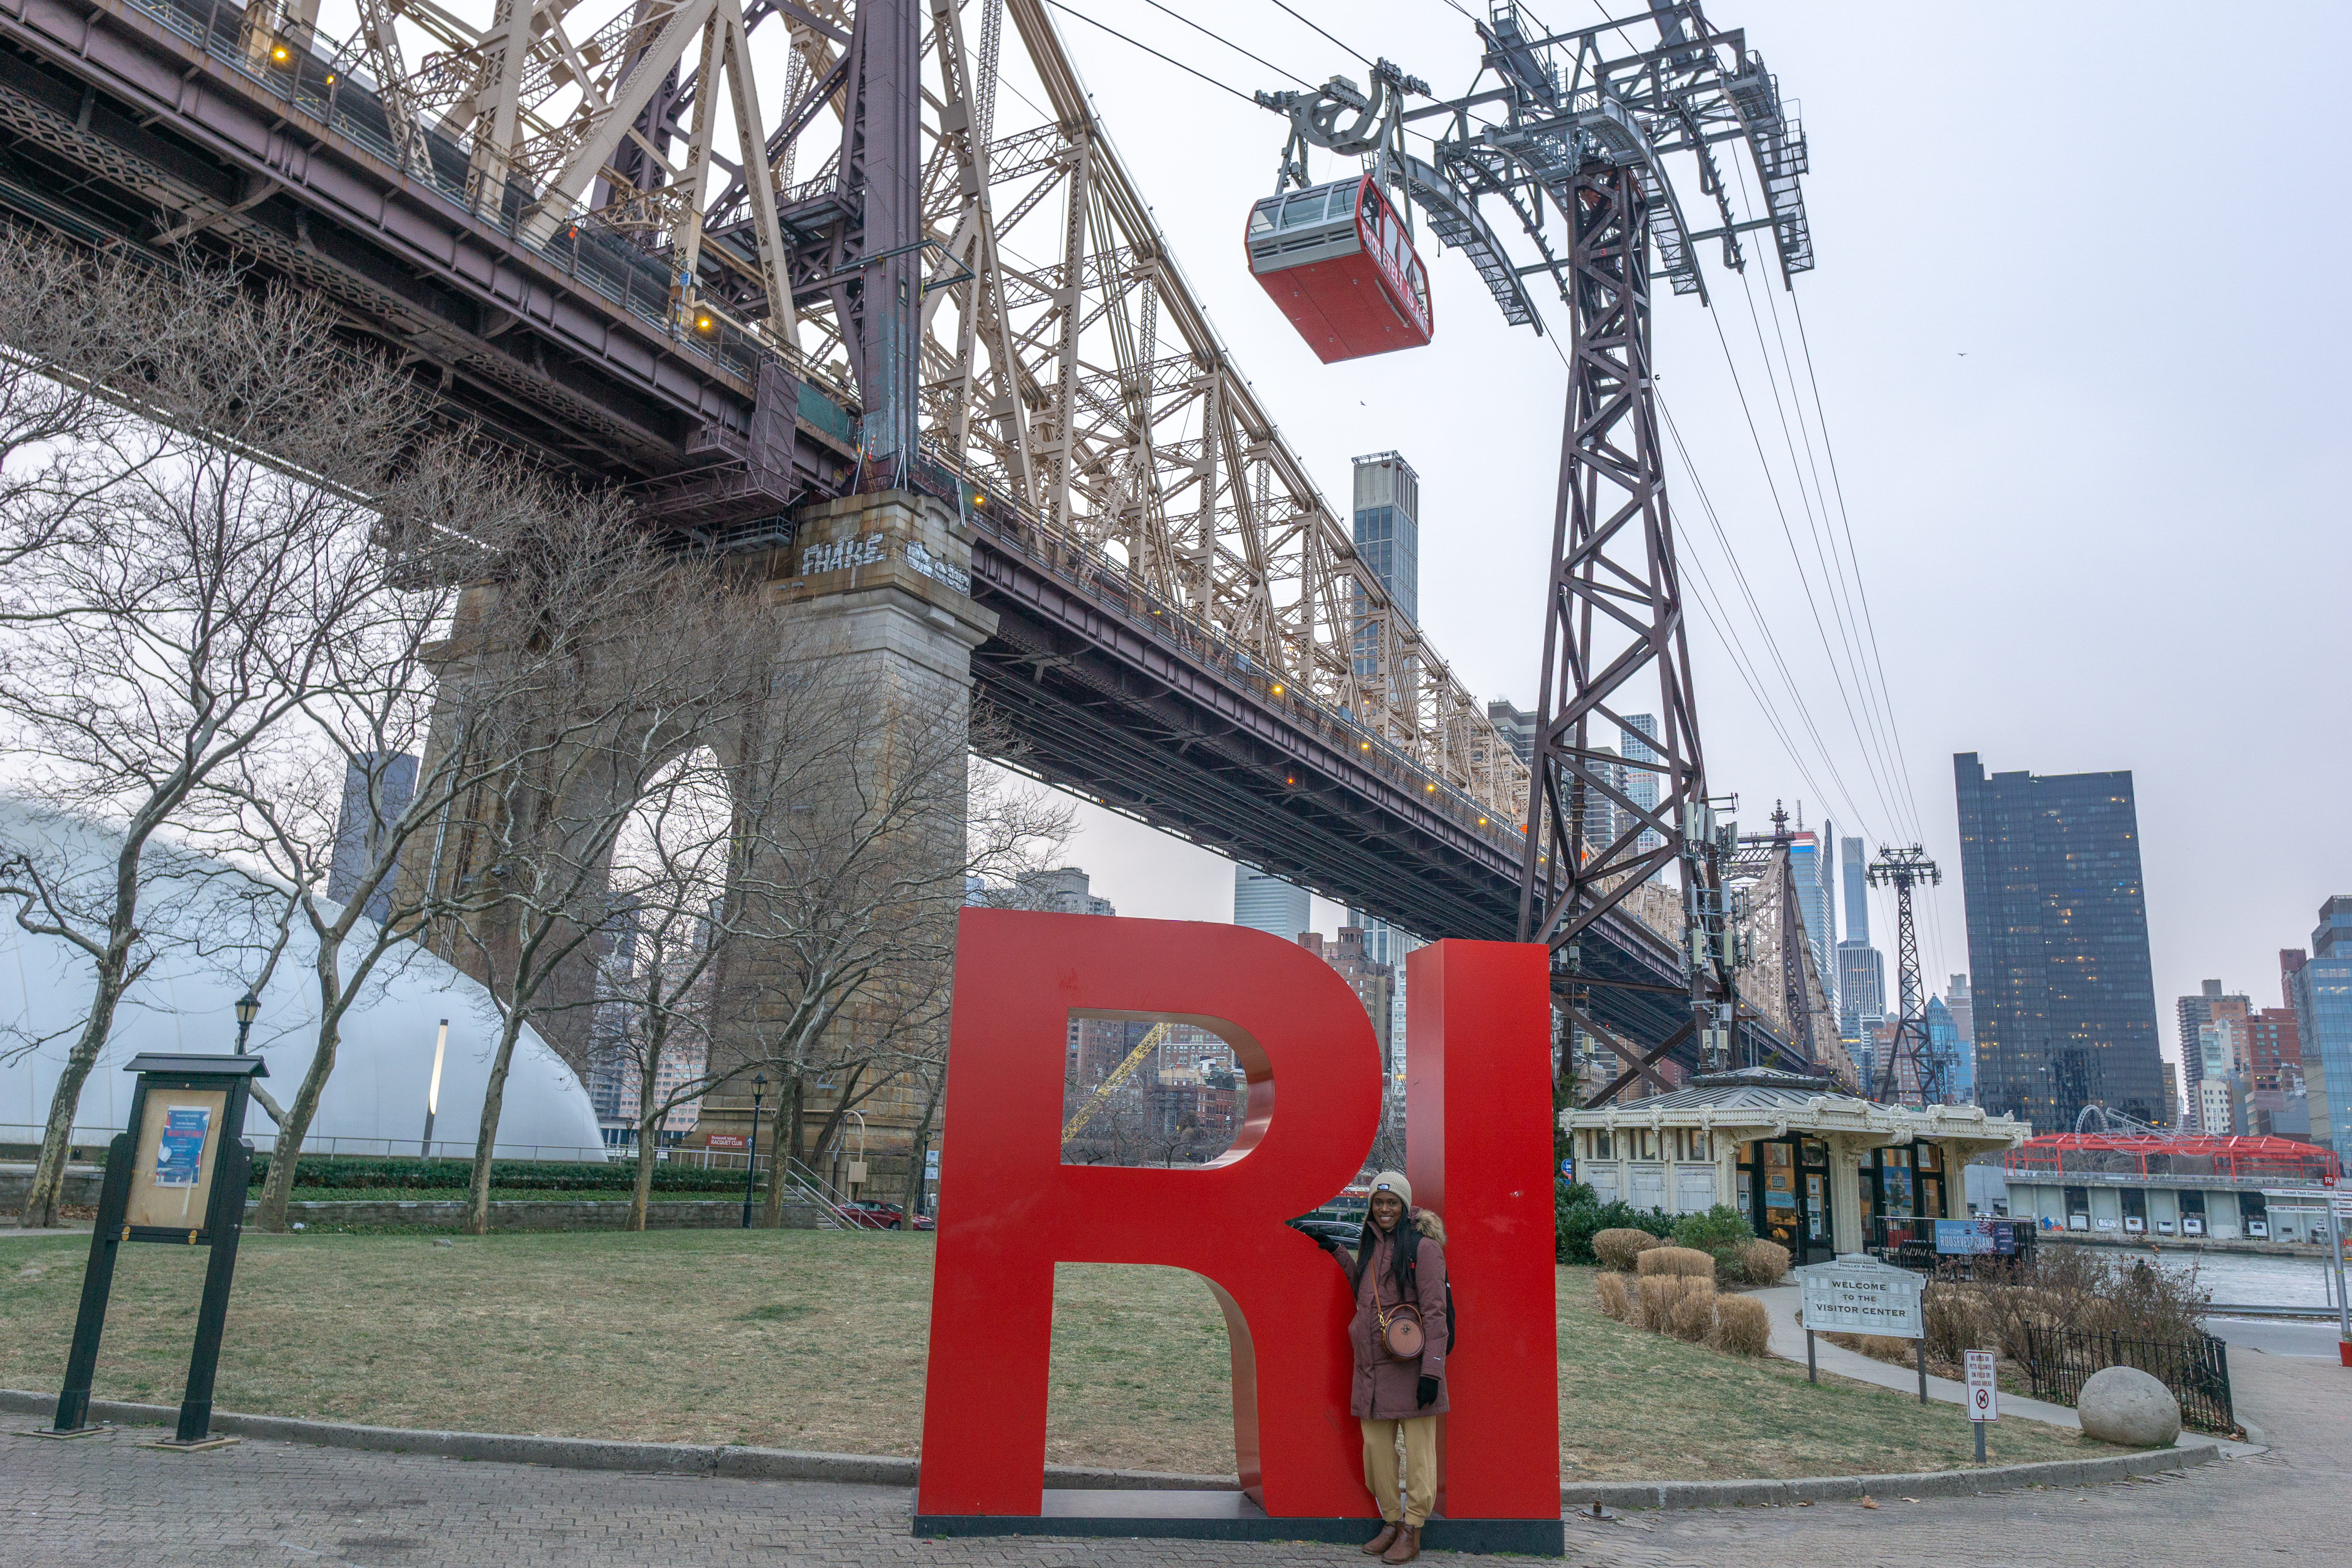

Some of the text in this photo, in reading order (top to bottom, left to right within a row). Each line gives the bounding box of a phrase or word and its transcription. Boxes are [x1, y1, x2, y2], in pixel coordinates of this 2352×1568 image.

[1362, 222, 1428, 334] ROOSEVELT ISAND
[916, 906, 1561, 1519] RI
[1940, 1236, 1994, 1248] ROOSEVELT ISLAND
[1832, 1281, 1886, 1290] WELCOME
[1816, 1304, 1906, 1317] VISITOR CENTER
